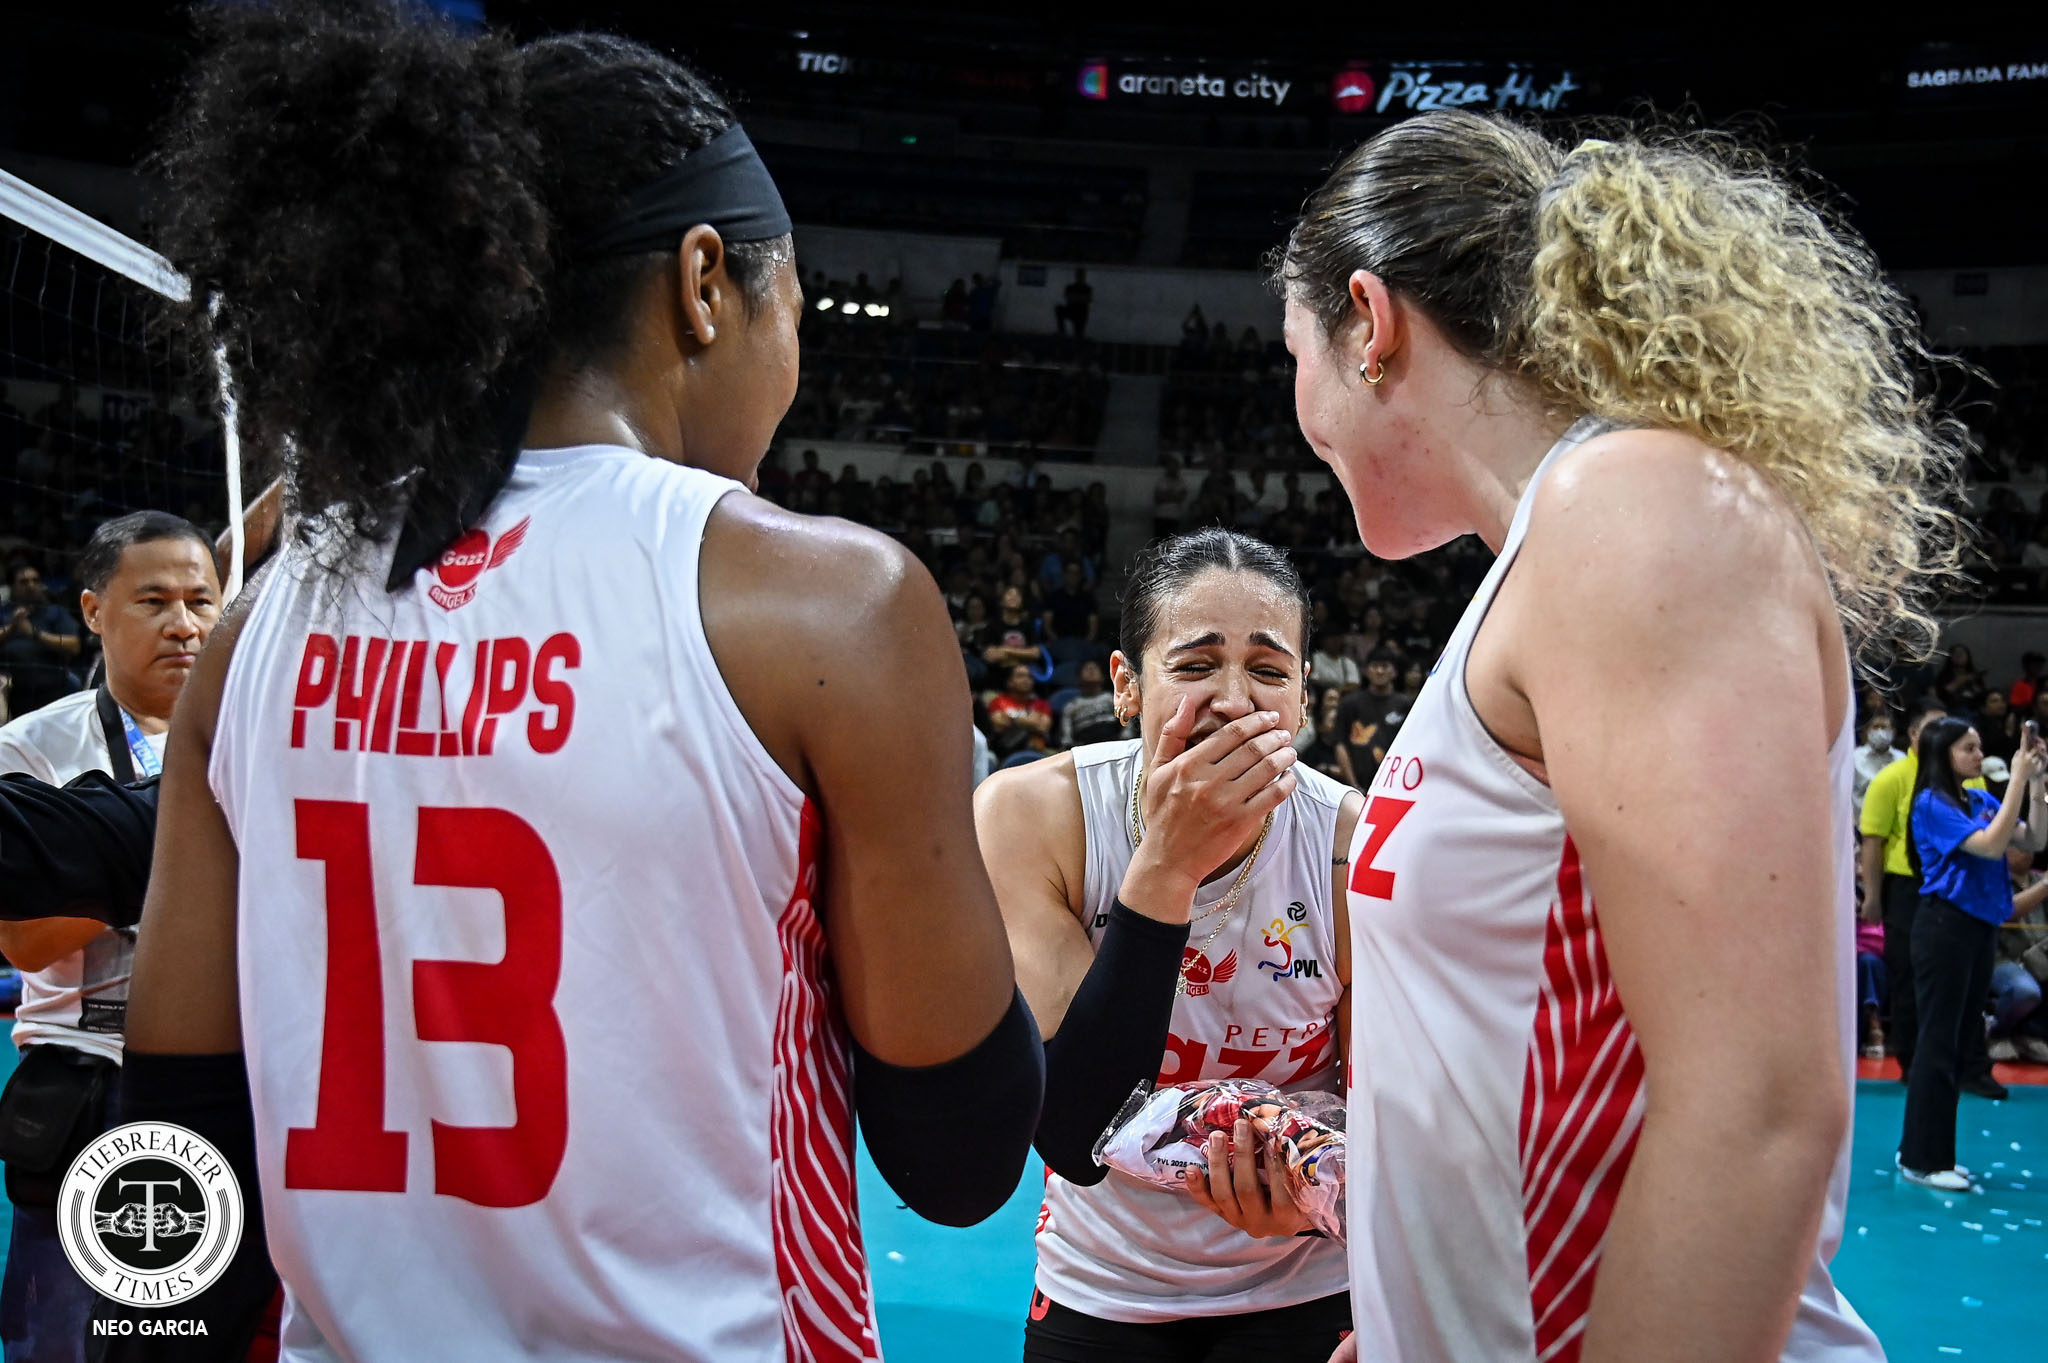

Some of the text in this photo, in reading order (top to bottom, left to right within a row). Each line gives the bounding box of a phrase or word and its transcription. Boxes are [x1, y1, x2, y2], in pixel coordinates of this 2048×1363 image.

[1119, 73, 1291, 106] araneta city
[1376, 70, 1580, 114] Pizza Hut
[1907, 66, 2003, 88] SAGRADA
[291, 632, 582, 757] PHILLIPS
[1293, 959, 1323, 979] PVL
[285, 798, 569, 1208] 13
[1171, 1159, 1188, 1168] 2025
